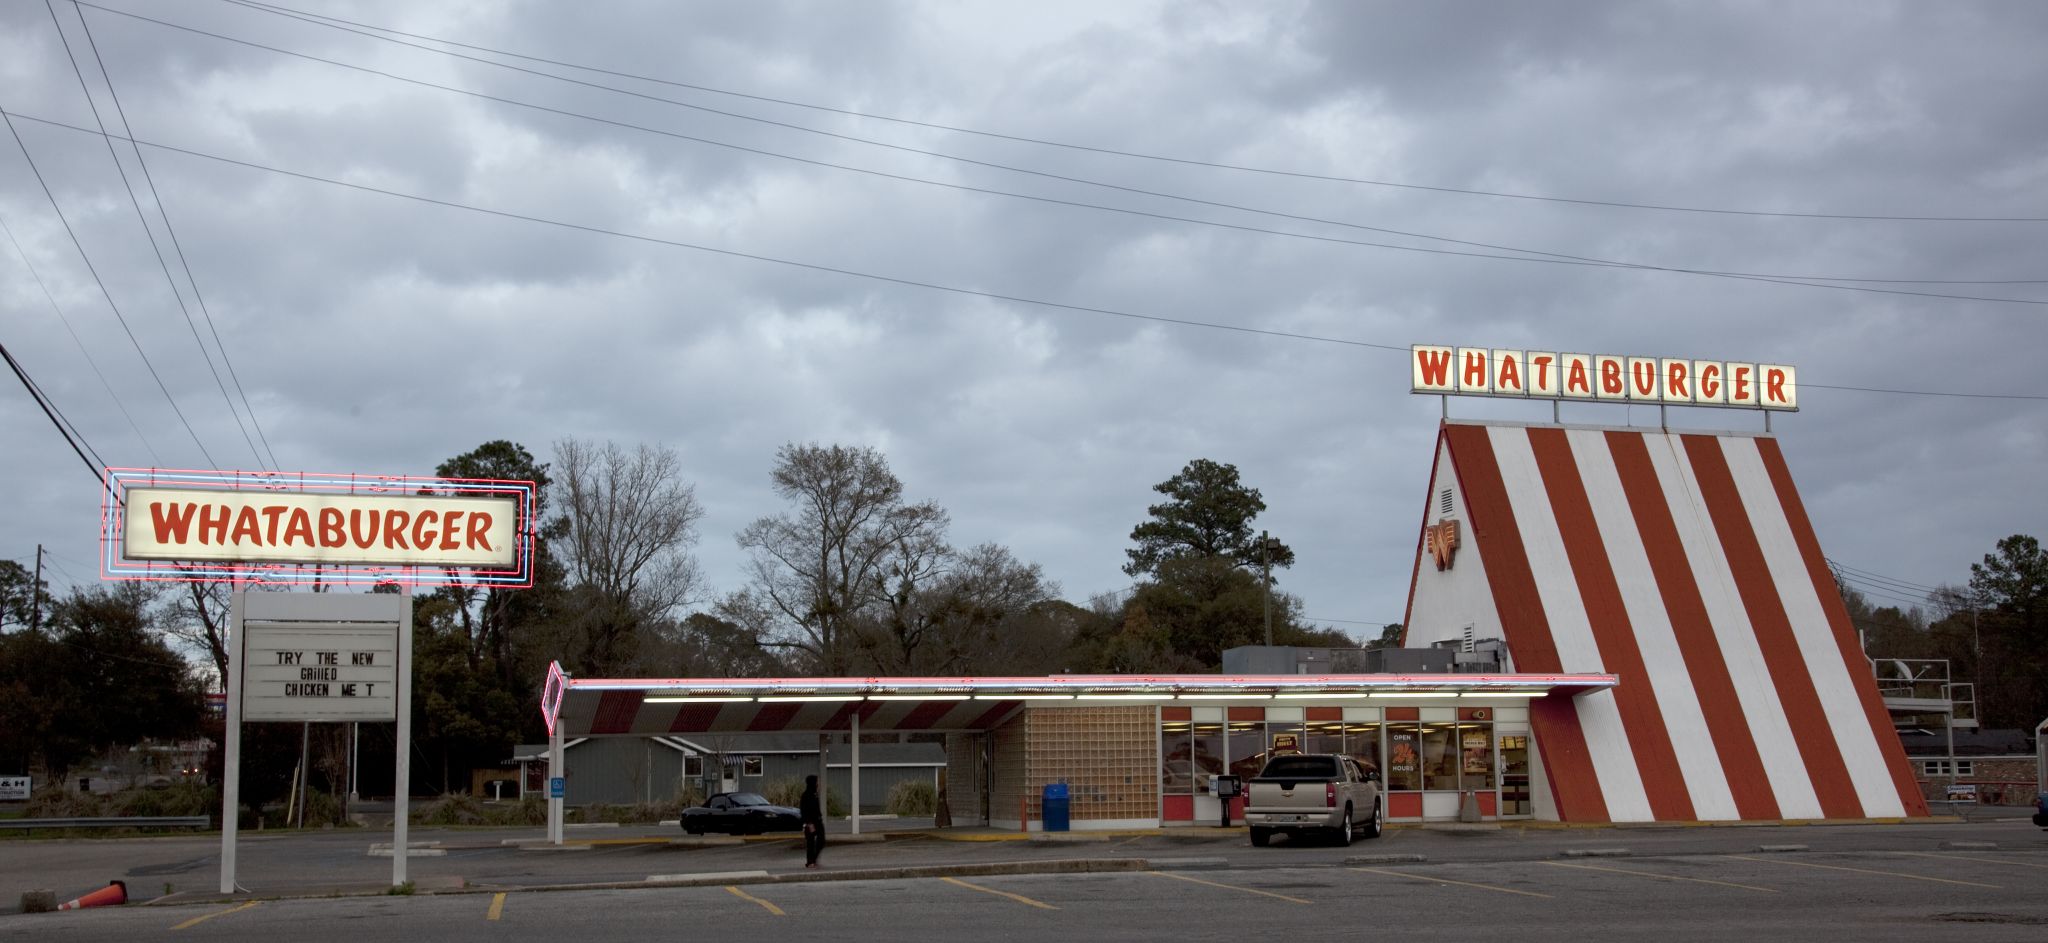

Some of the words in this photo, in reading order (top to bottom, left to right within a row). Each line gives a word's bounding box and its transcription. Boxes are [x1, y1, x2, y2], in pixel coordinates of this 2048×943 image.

[1418, 350, 1786, 403] WHATABURGER
[149, 502, 493, 552] WHATABURGER
[276, 651, 303, 665] TRY
[316, 652, 338, 665] THE
[352, 652, 374, 665] NEW
[285, 683, 329, 697] CHICKEN
[1392, 743, 1416, 764] 24
